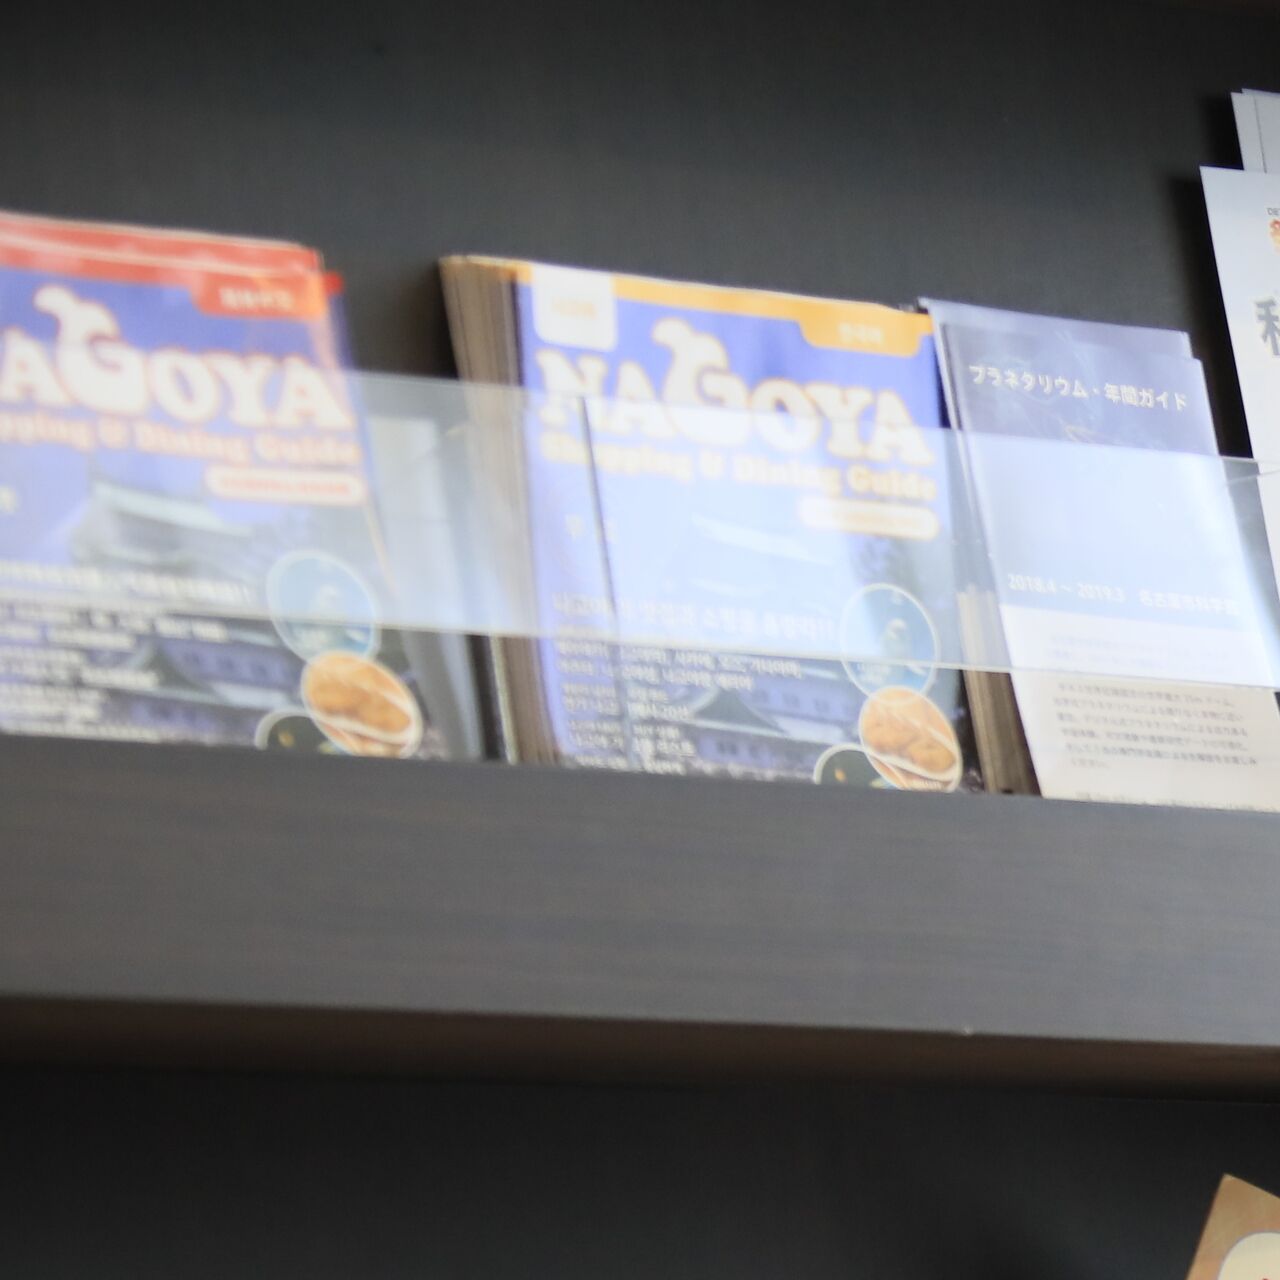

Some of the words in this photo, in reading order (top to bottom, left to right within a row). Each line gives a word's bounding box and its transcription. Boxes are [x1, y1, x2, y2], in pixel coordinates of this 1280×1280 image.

[536, 318, 936, 466] NAGOYA
[969, 365, 1188, 411] プラネタリウム・年間ガイド
[846, 466, 938, 500] Guide
